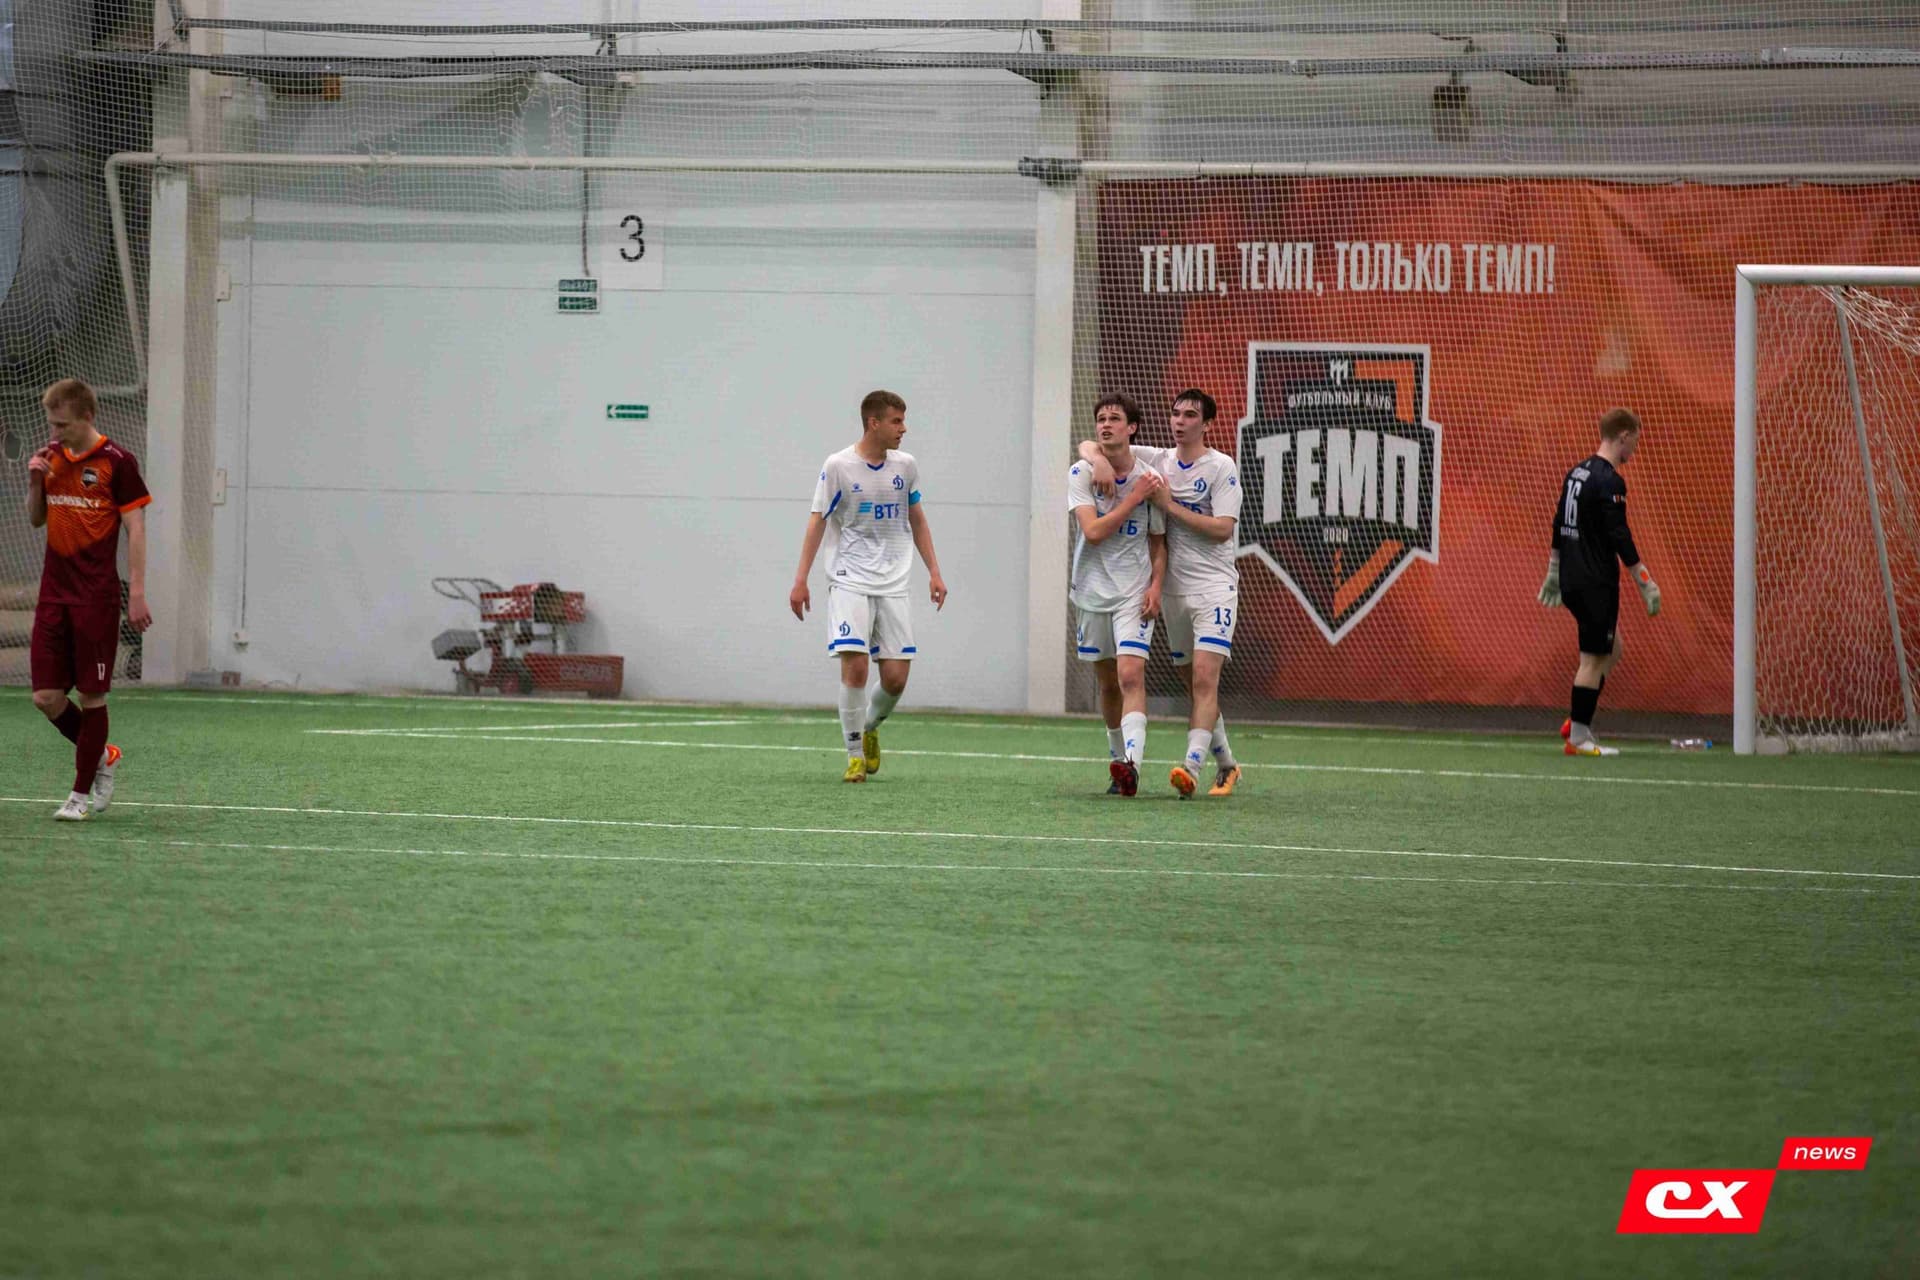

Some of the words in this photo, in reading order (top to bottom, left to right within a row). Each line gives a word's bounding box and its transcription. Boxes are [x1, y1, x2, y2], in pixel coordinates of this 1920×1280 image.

[619, 214, 645, 262] 3
[1139, 242, 1227, 296] ТЕМП,
[1237, 241, 1324, 296] ТЕМП,
[1335, 240, 1451, 292] ТОЛЬКО
[1462, 242, 1556, 294] ТЕМП!
[1288, 389, 1360, 408] ФУТБОЛЬНЫЙ
[1365, 391, 1392, 410] КЛУБ
[1256, 428, 1420, 530] ТЕМП
[1564, 479, 1583, 527] 16
[1214, 607, 1232, 627] 13
